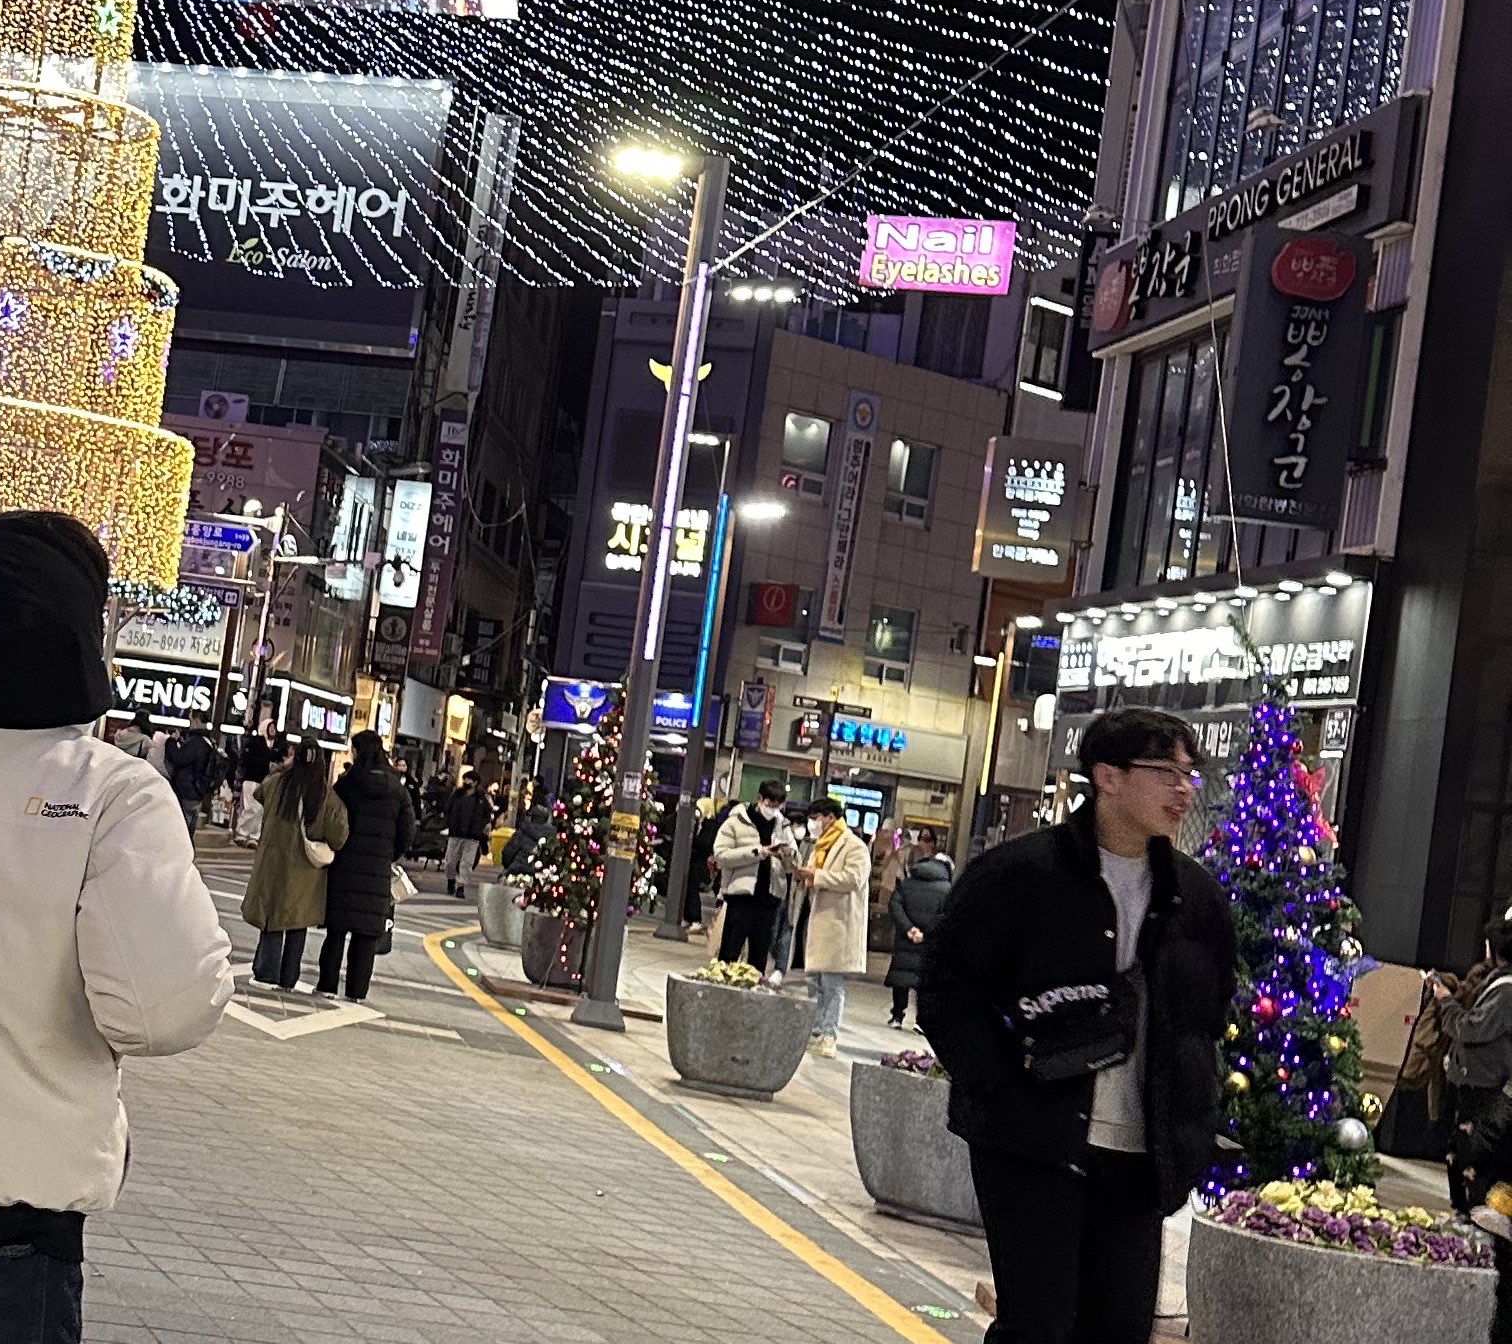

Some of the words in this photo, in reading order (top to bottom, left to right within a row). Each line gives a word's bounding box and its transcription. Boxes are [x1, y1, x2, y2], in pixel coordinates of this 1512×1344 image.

[1207, 179, 1270, 237] PPONG
[1276, 131, 1363, 206] GENERAL
[155, 173, 407, 237] 화미주헤어
[875, 222, 994, 255] Nail
[870, 252, 1001, 288] Eyelashes
[1267, 322, 1329, 490] 뽕장군
[430, 448, 461, 555] 화미주헤어
[607, 522, 706, 562] 시널
[114, 675, 211, 711] VENUS
[655, 716, 688, 729] POLICE
[44, 802, 80, 811] NATIONAL
[1018, 984, 1110, 1021] Supreme
